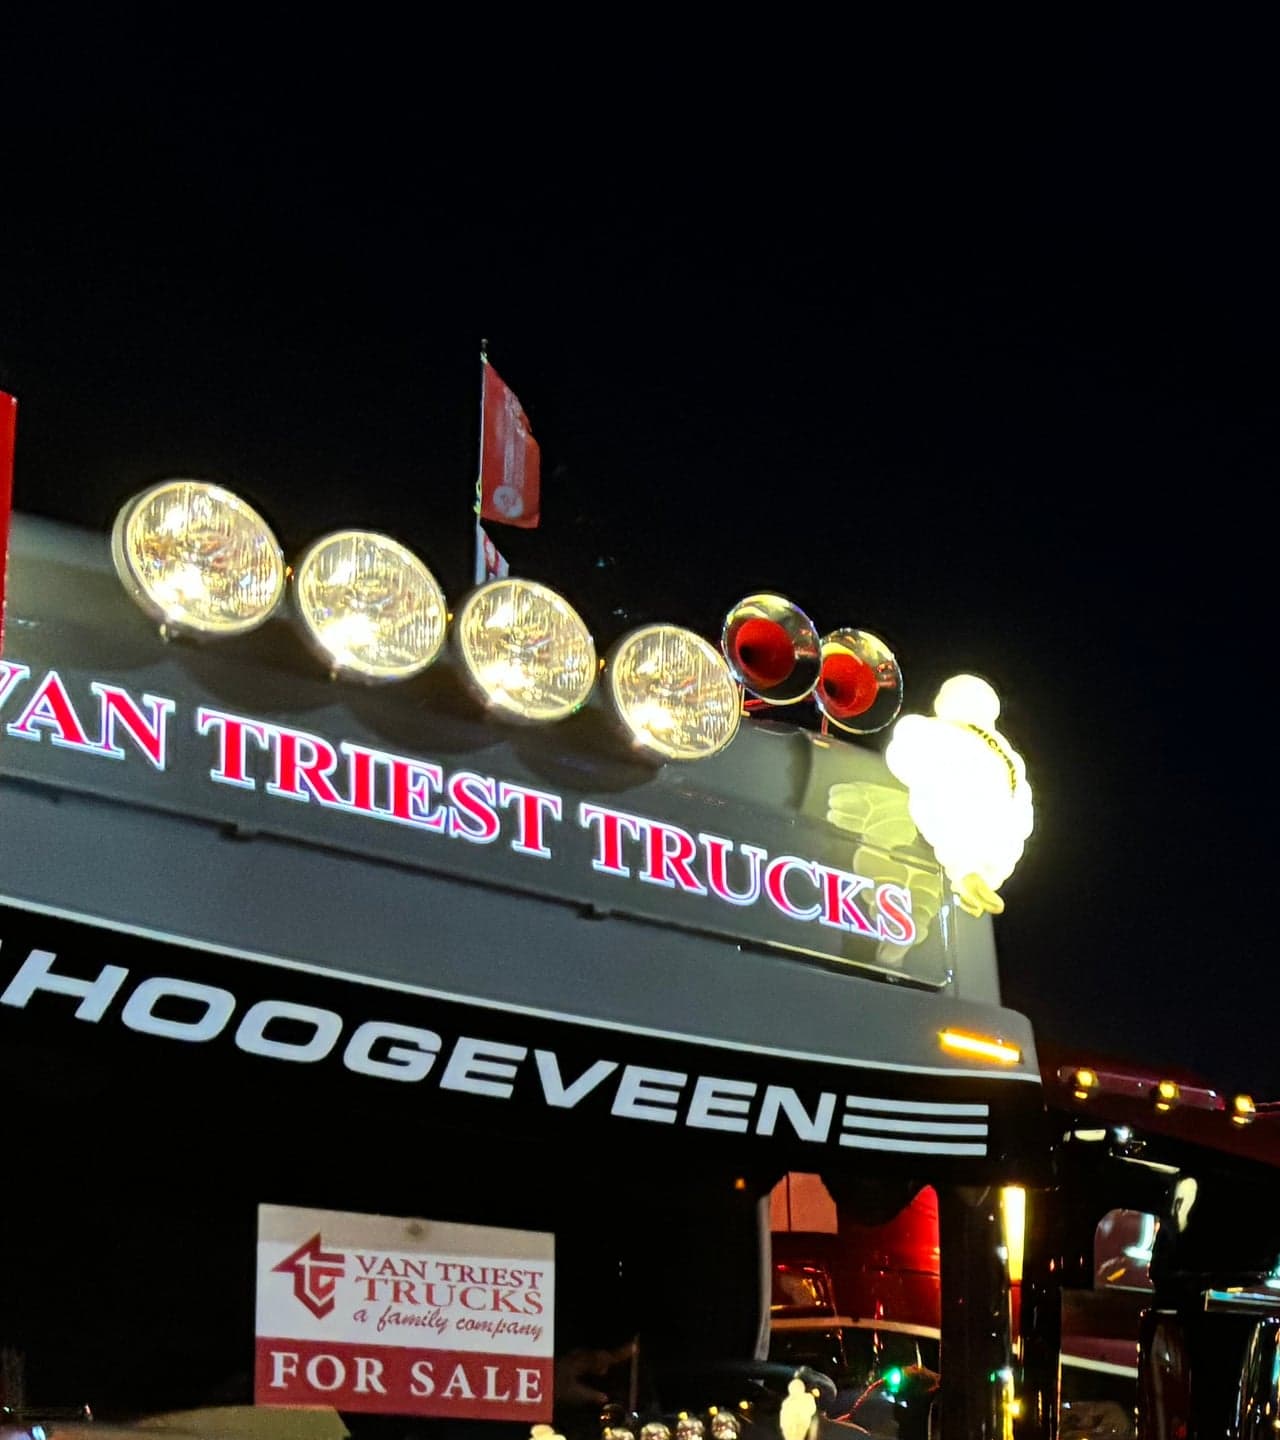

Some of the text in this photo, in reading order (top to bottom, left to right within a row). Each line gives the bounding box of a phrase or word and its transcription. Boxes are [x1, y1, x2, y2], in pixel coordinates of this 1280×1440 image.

[195, 708, 562, 859] TRIEST
[580, 801, 917, 947] TRUCKS
[0, 950, 837, 1145] HOOGEVEEN
[355, 1255, 544, 1290] VAN TRIEST
[353, 1276, 544, 1315] TRUCKS
[353, 1304, 543, 1342] a family company
[269, 1351, 543, 1403] FOR SALE
